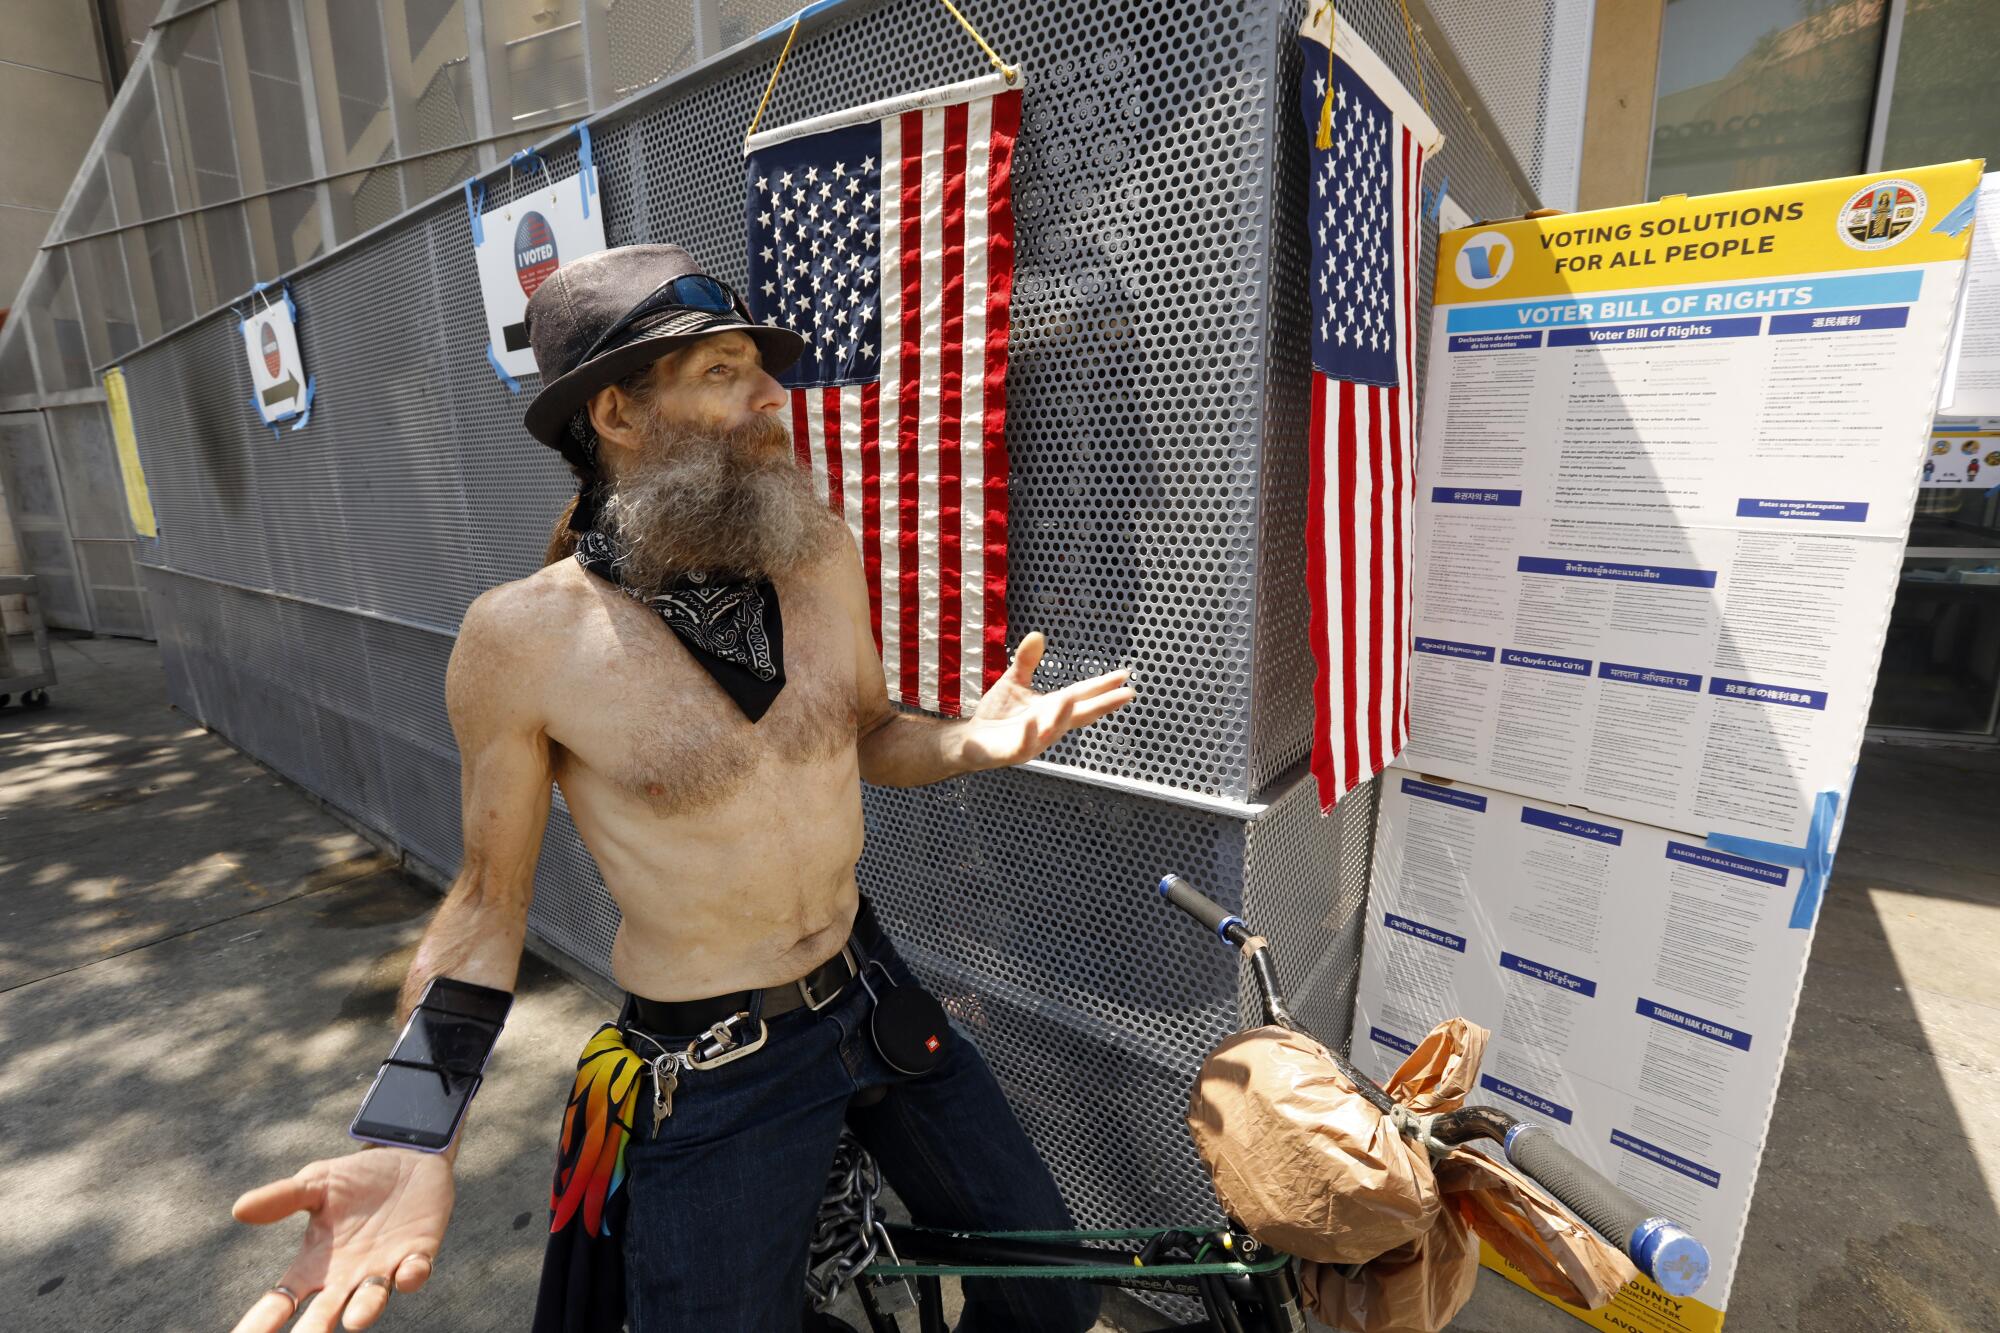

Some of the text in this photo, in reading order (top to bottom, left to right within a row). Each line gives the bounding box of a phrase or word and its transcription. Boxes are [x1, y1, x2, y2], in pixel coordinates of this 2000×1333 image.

[1540, 224, 1632, 249] VOTING
[1640, 202, 1804, 238] SOLUTIONS
[518, 244, 553, 268] I VOTED
[1555, 235, 1775, 274] FOR ALL PEOPLE
[1517, 286, 1814, 324] VOTER BILL OF RIGHTS
[1458, 336, 1494, 344] Declaración
[1503, 333, 1532, 342] derechos
[1589, 324, 1712, 342] Voter Bill of Rights
[1508, 654, 1521, 662] Các
[1672, 848, 1696, 858] ЗАКОН
[1702, 855, 1730, 866] ПРАВАХ
[1653, 1006, 1733, 1040] TAGIHAN HAK PEMILIH
[1120, 1280, 1199, 1294] FreeAge
[1625, 1280, 1683, 1311] OUNTY
[1620, 1286, 1651, 1304] OUNTY
[1652, 1302, 1680, 1320] CLERK
[1604, 1312, 1643, 1333] LAVO
